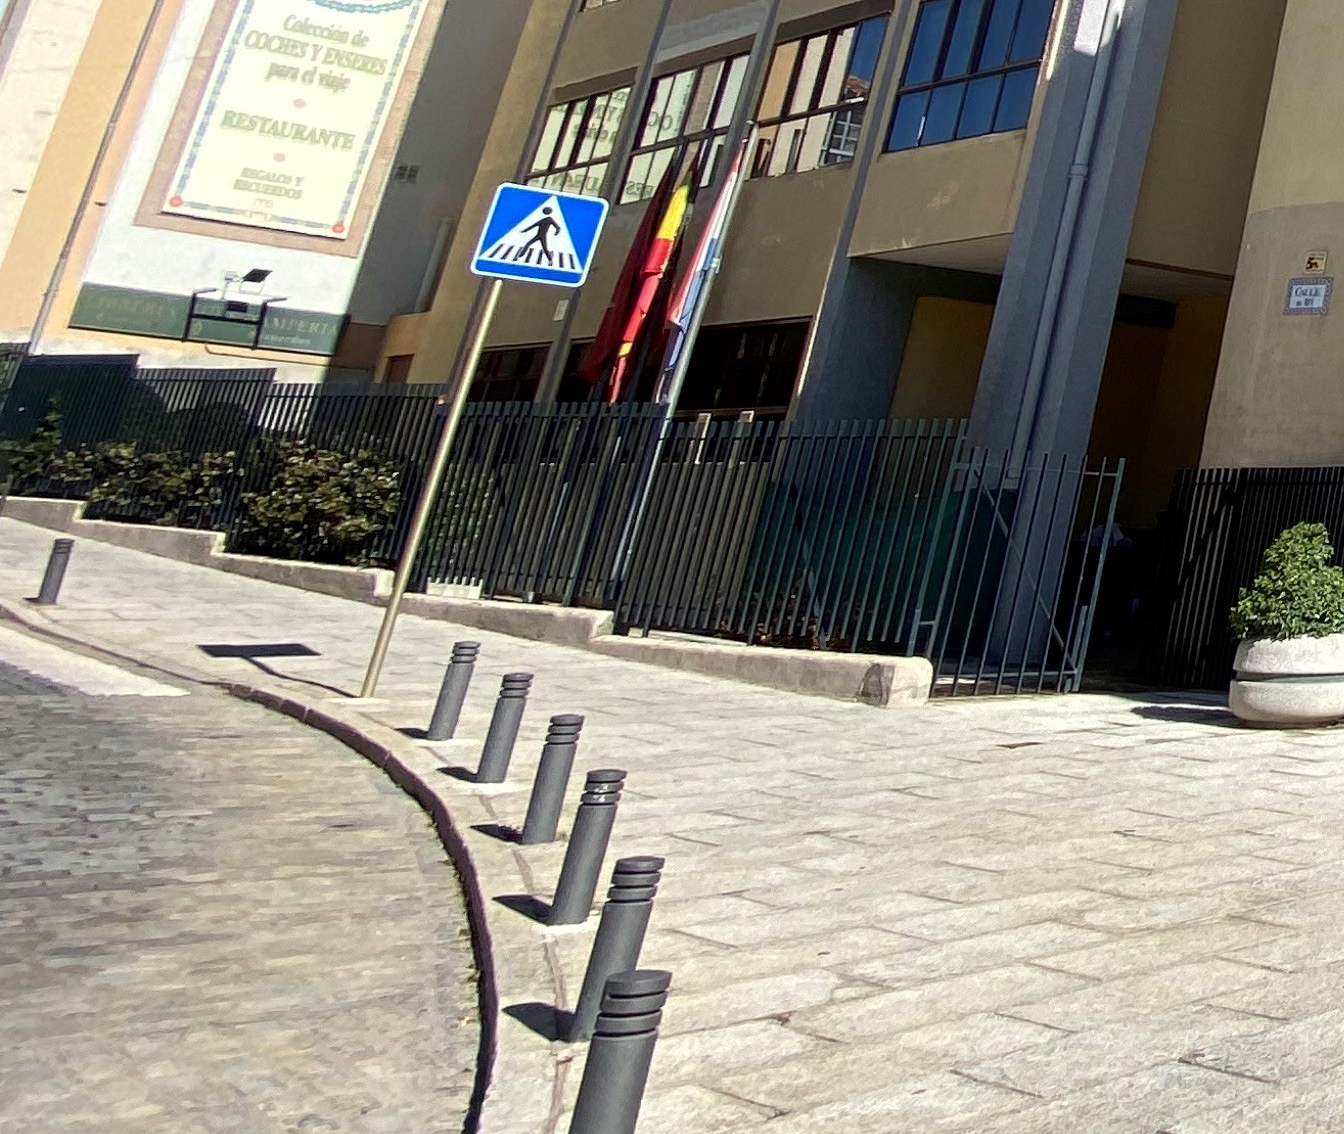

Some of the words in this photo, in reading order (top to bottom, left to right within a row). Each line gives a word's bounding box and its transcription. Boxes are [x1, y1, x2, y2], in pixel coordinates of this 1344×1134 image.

[244, 30, 309, 58] COCHES
[310, 44, 324, 62] Y
[351, 30, 370, 47] de
[221, 110, 356, 150] RESTAURANTE
